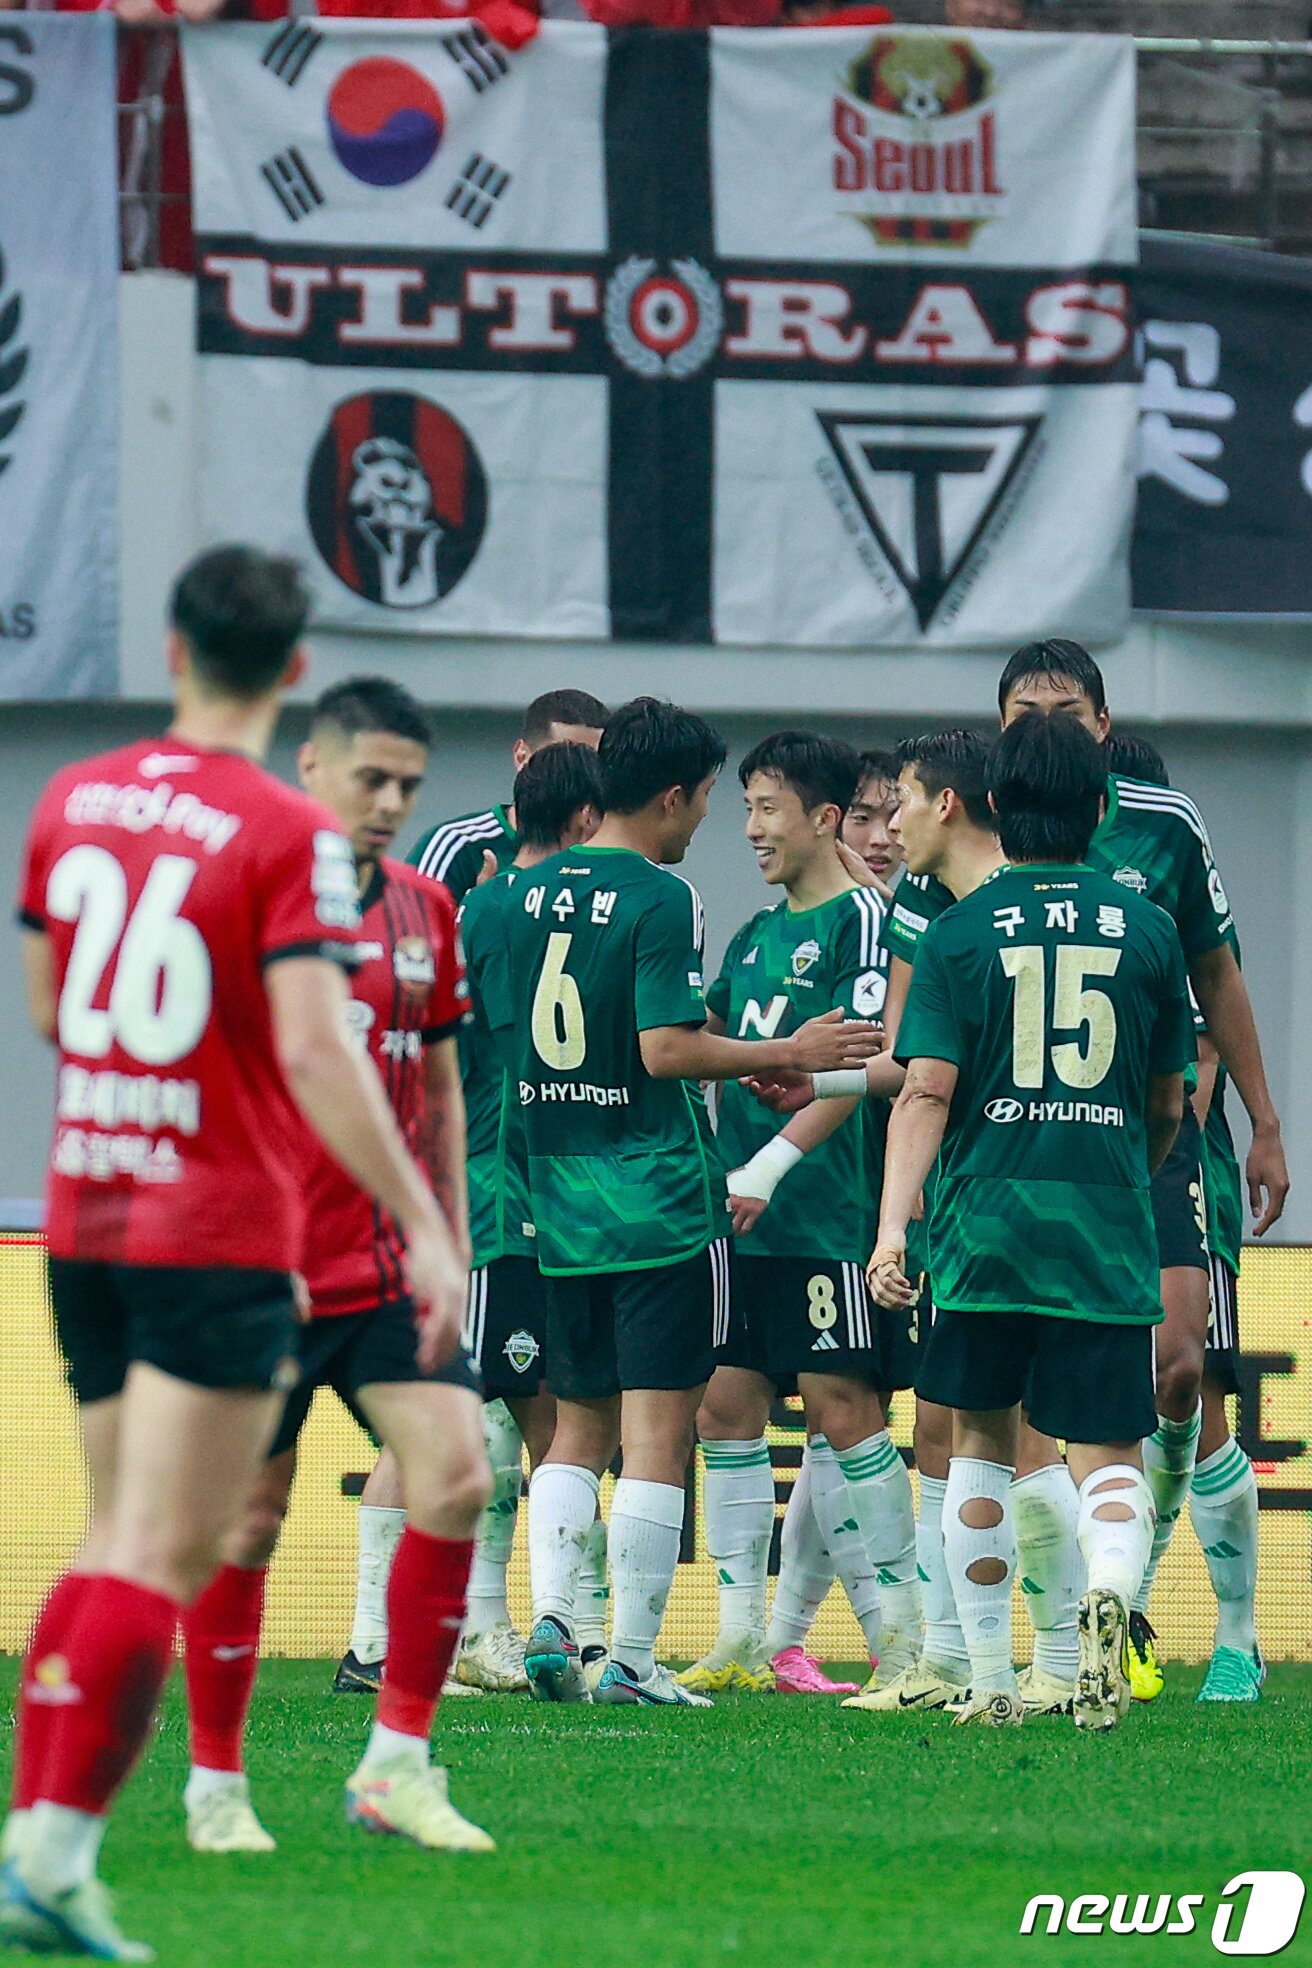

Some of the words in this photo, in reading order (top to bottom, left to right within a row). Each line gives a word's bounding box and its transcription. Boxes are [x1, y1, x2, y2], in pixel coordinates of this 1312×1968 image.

[831, 95, 1004, 195] Seoul
[524, 885, 618, 925] 이수빈
[993, 900, 1126, 938] 구자룡
[46, 843, 213, 1066] 26
[531, 931, 586, 1071] 6
[999, 944, 1122, 1089] 15
[540, 1083, 629, 1106] HYUNDAI
[1028, 1101, 1124, 1127] HYUNDAI
[807, 1274, 837, 1329] 8
